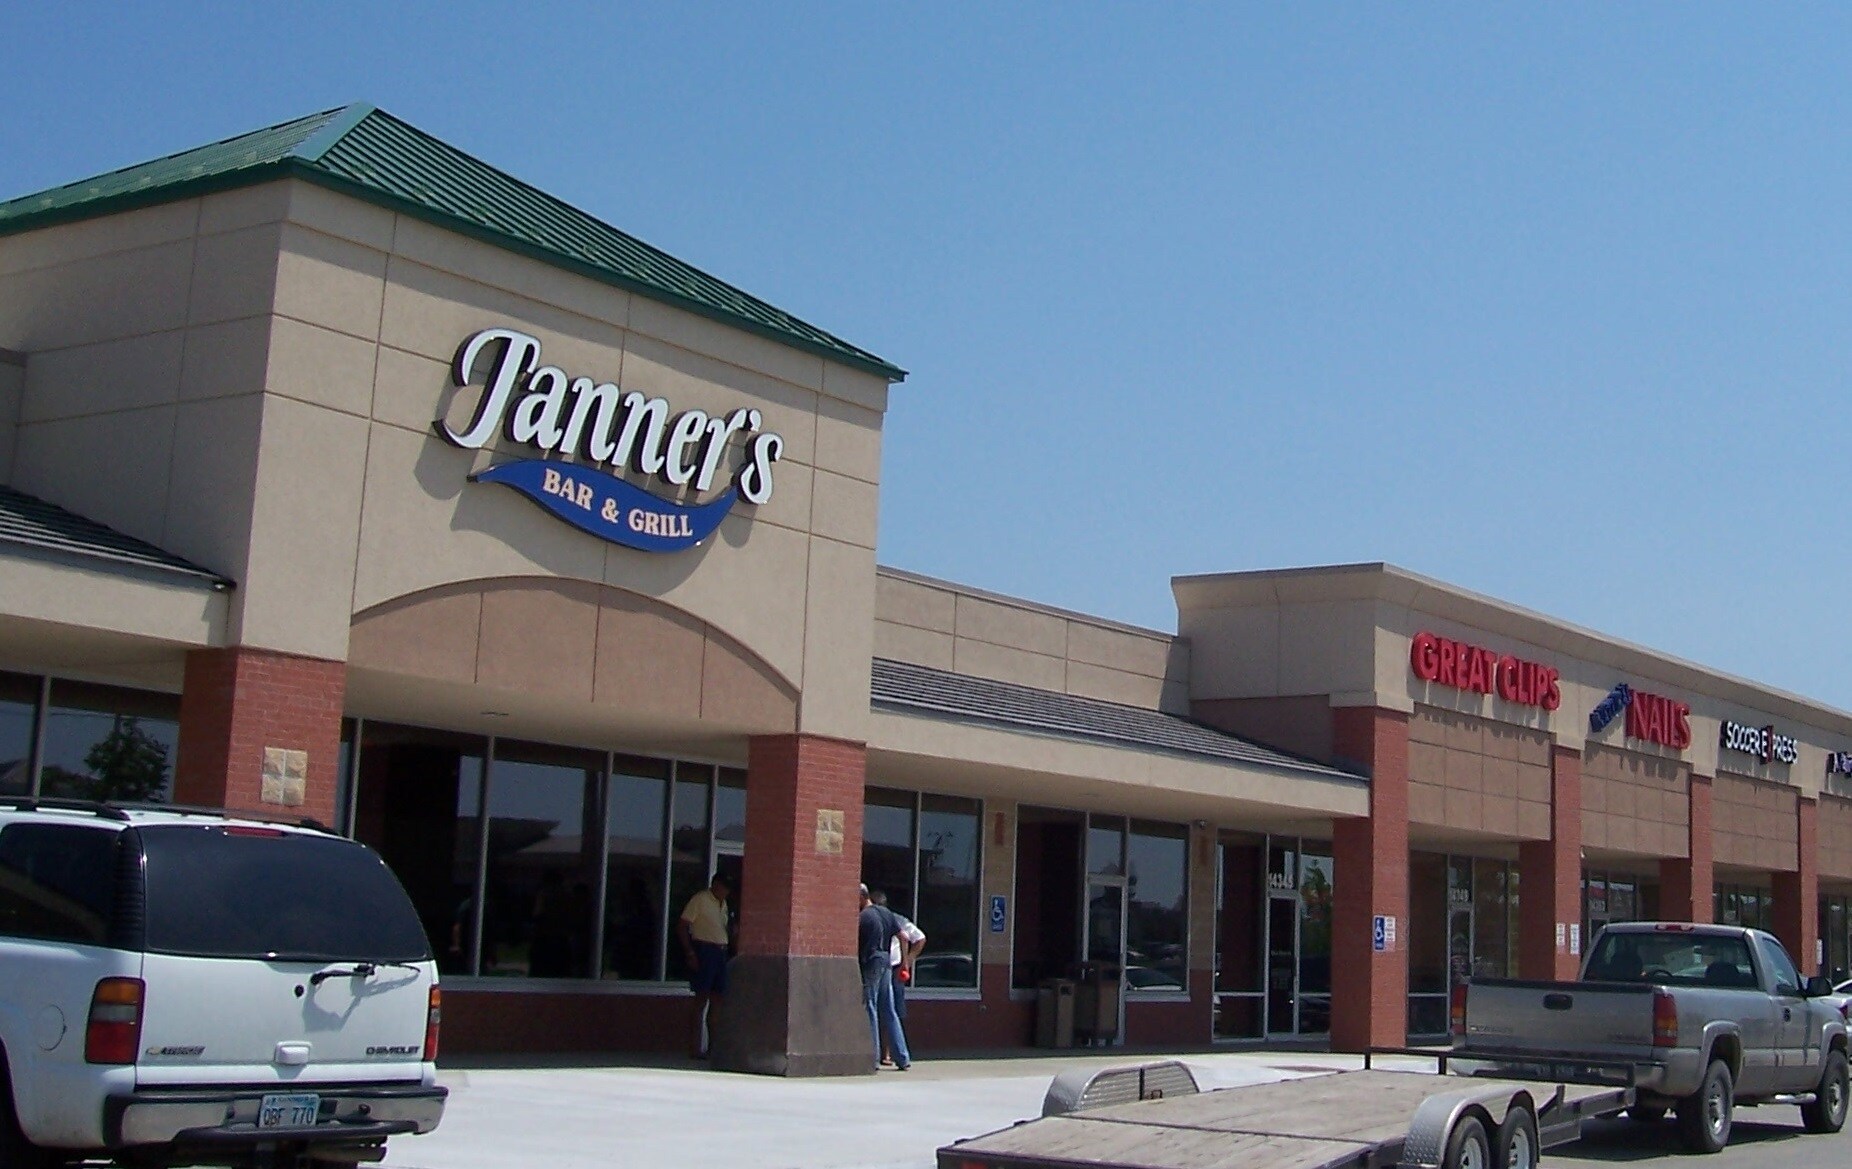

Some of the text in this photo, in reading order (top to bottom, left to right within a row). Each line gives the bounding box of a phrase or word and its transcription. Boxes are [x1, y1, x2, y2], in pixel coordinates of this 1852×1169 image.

[434, 327, 785, 504] Tanner's
[543, 468, 693, 538] BAR & GRILL
[1411, 630, 1496, 694] GREAT
[1496, 654, 1561, 711] CLIPS
[1626, 690, 1691, 750] NAILS
[1724, 720, 1761, 755] SOCCER
[1761, 726, 1799, 764] EPRESS
[292, 1107, 315, 1125] 770
